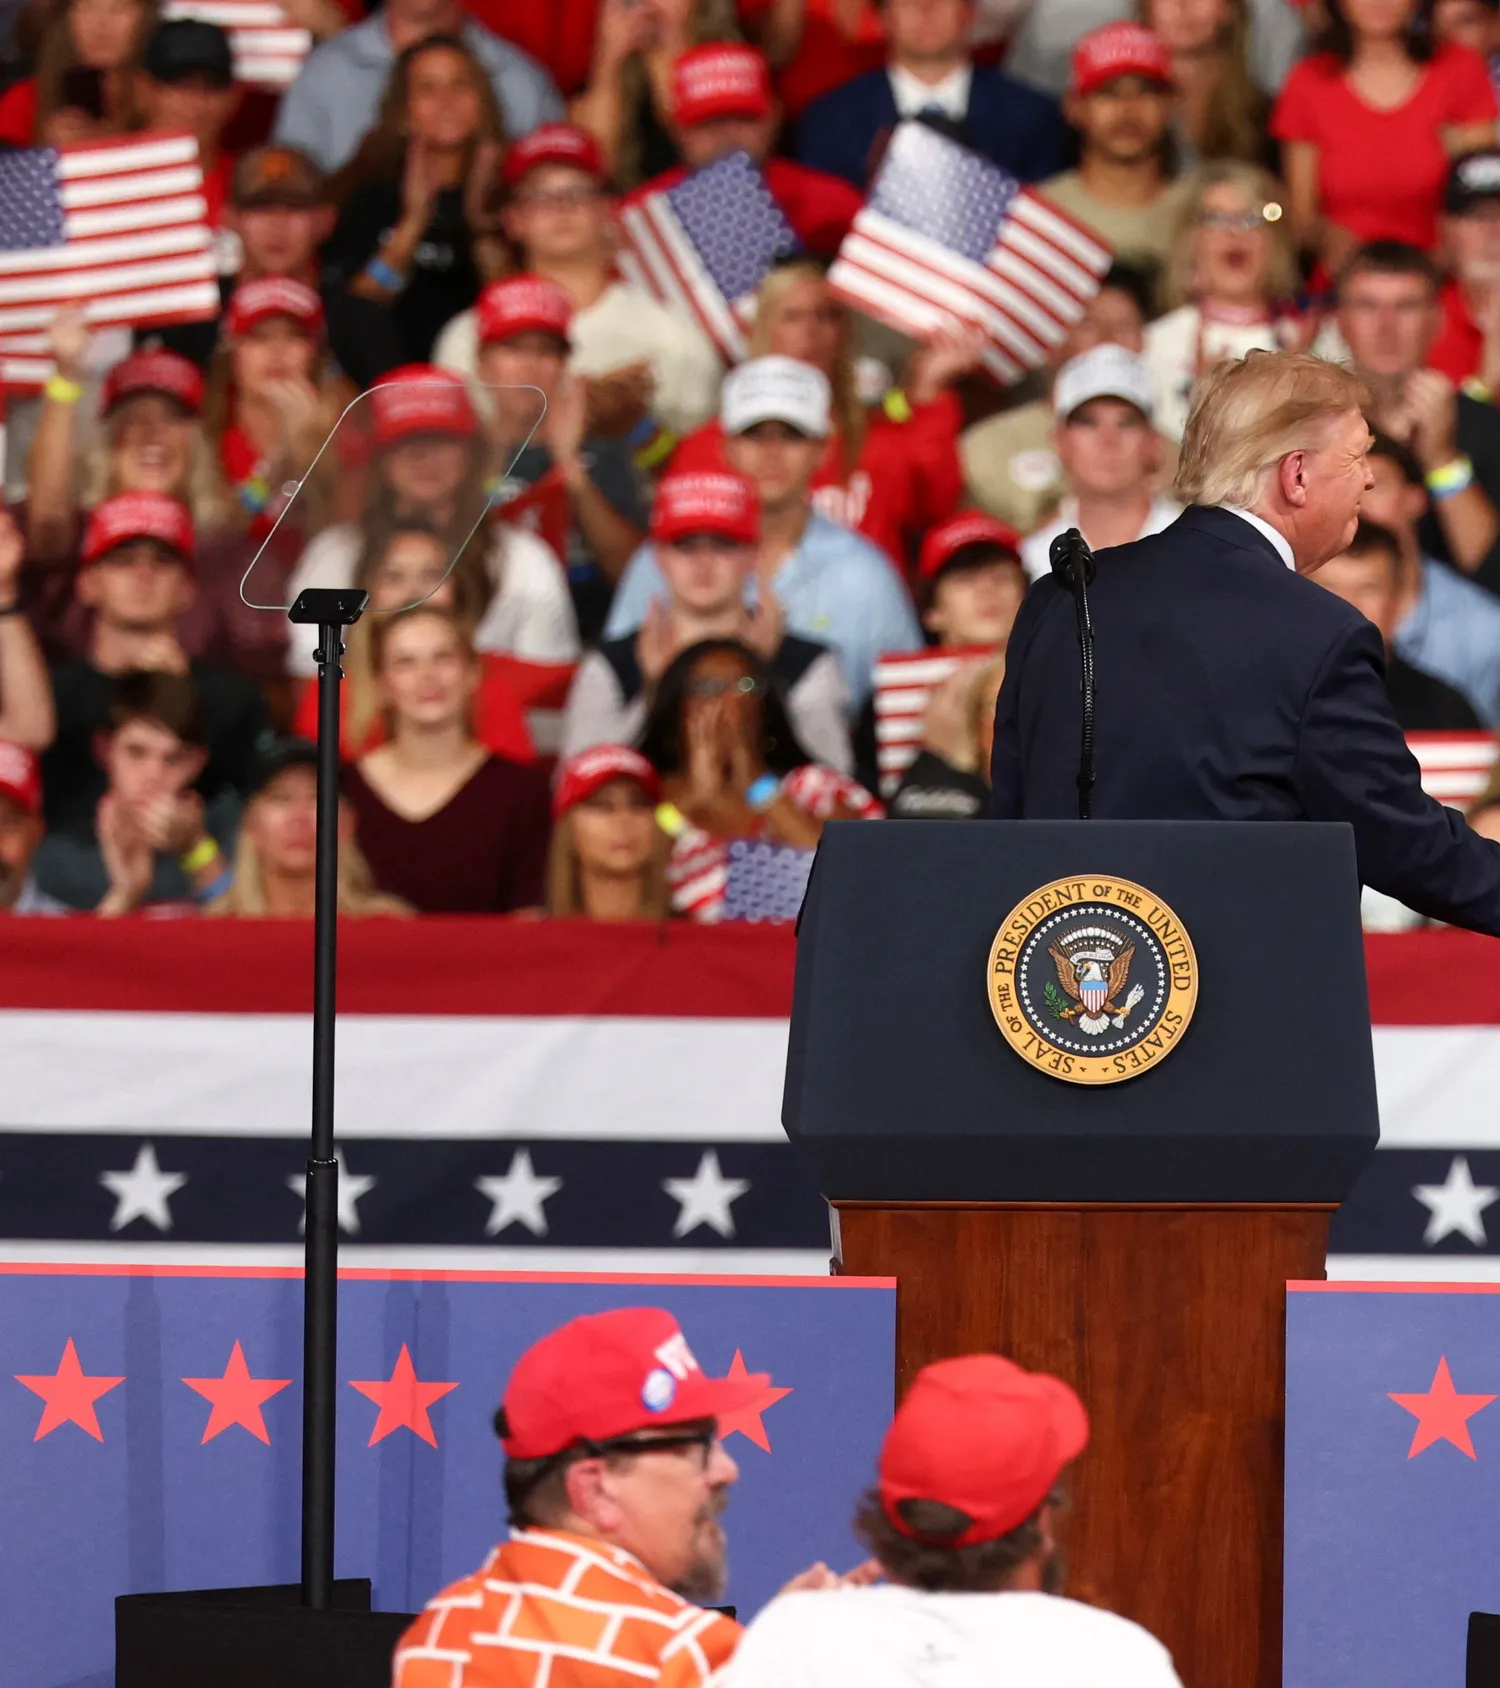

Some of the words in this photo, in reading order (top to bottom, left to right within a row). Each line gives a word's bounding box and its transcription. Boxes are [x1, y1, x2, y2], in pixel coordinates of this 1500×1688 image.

[1092, 884, 1112, 897] OF
[1116, 888, 1143, 909] THE
[995, 882, 1087, 975] PRESIDENT
[1147, 905, 1191, 991] UNITED
[997, 983, 1013, 1013] THE
[1006, 1014, 1023, 1034] OF
[1112, 1010, 1183, 1074] STATES
[1022, 1031, 1076, 1074] SEAL
